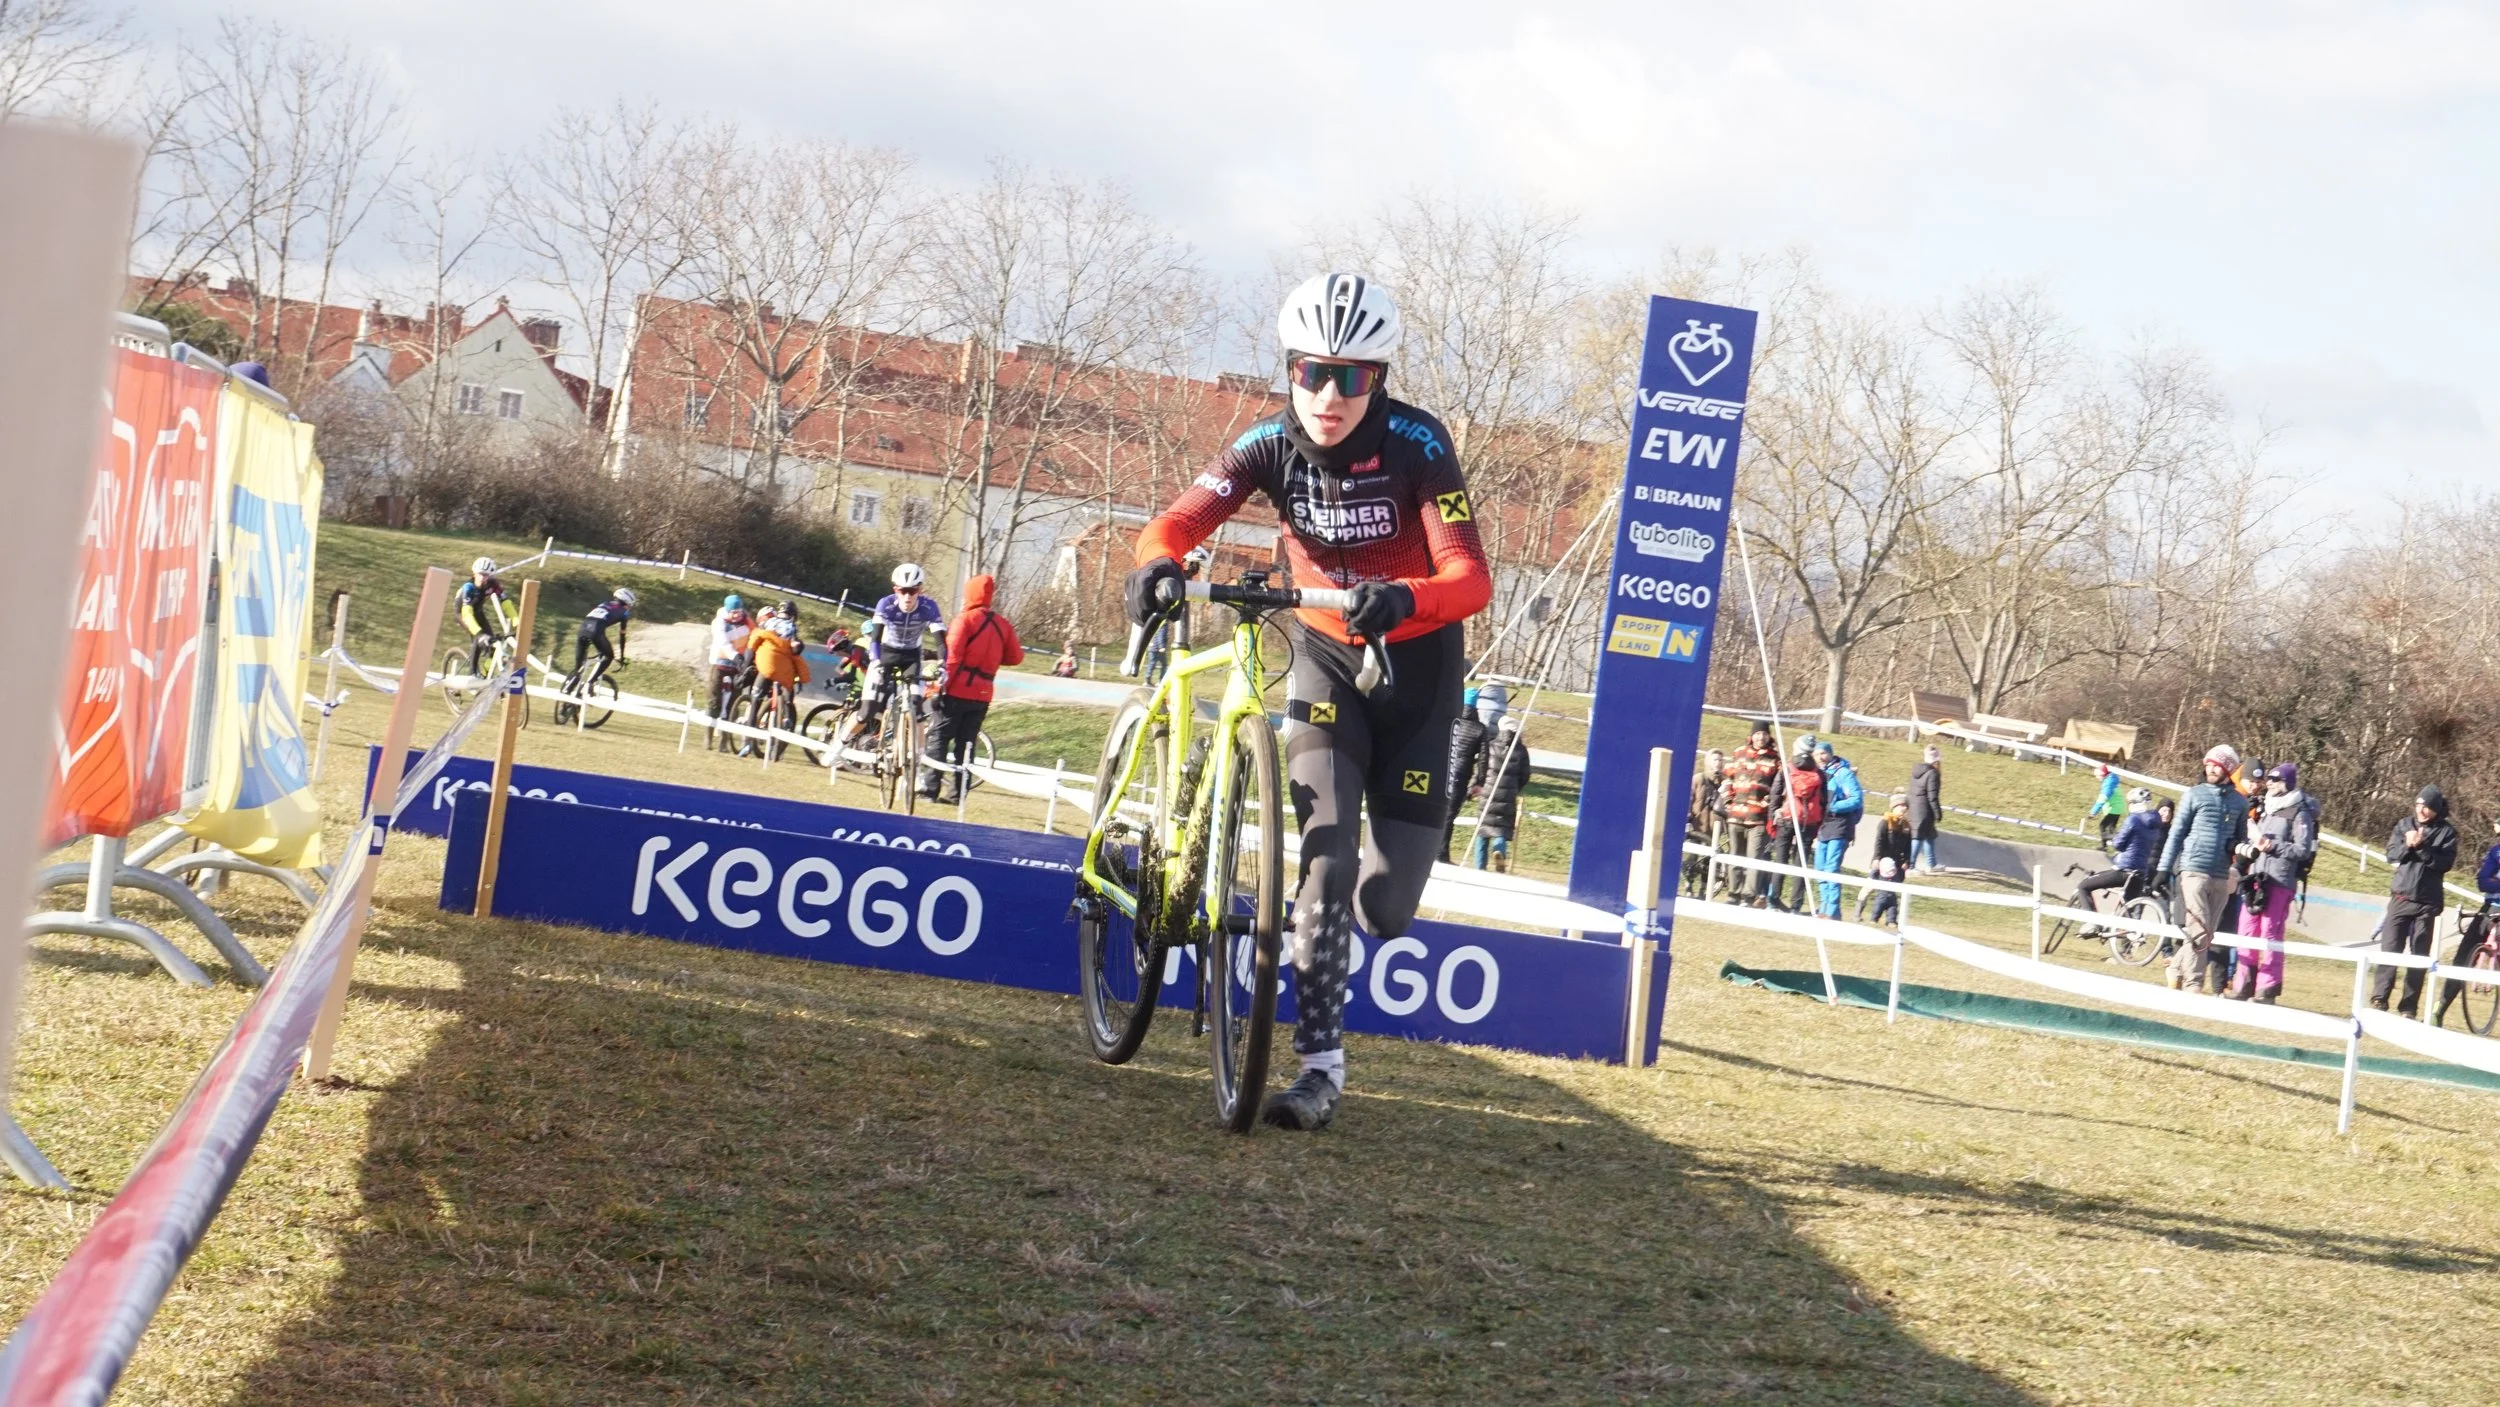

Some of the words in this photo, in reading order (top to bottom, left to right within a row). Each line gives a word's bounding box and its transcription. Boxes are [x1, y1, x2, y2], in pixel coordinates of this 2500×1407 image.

[1640, 427, 1727, 470] EVN
[1292, 502, 1391, 527] STEINER
[1294, 518, 1393, 541] SHOPPING
[1632, 522, 1713, 551] tubolito
[1621, 620, 1661, 634] SPORT
[1618, 639, 1651, 652] LAND
